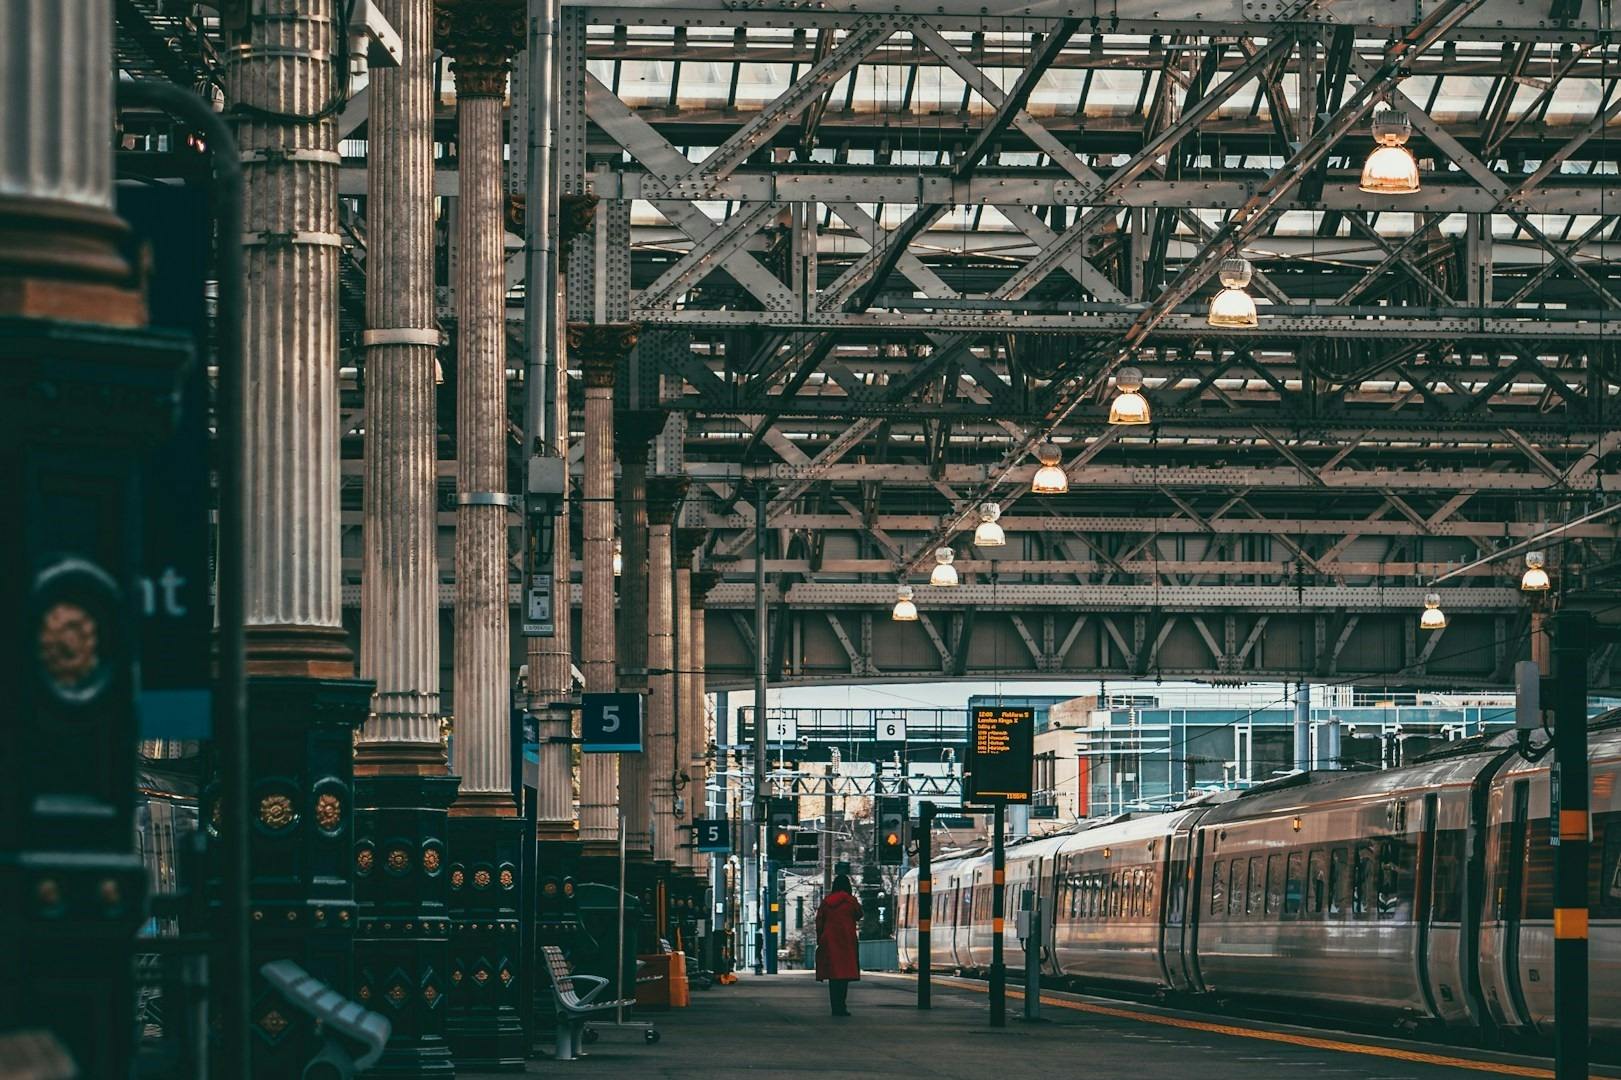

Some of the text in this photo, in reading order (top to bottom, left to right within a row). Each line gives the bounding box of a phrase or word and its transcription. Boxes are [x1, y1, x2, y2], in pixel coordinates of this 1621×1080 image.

[602, 705, 620, 733] 5
[777, 724, 786, 736] 5
[887, 724, 895, 736] 6
[708, 826, 719, 842] 5
